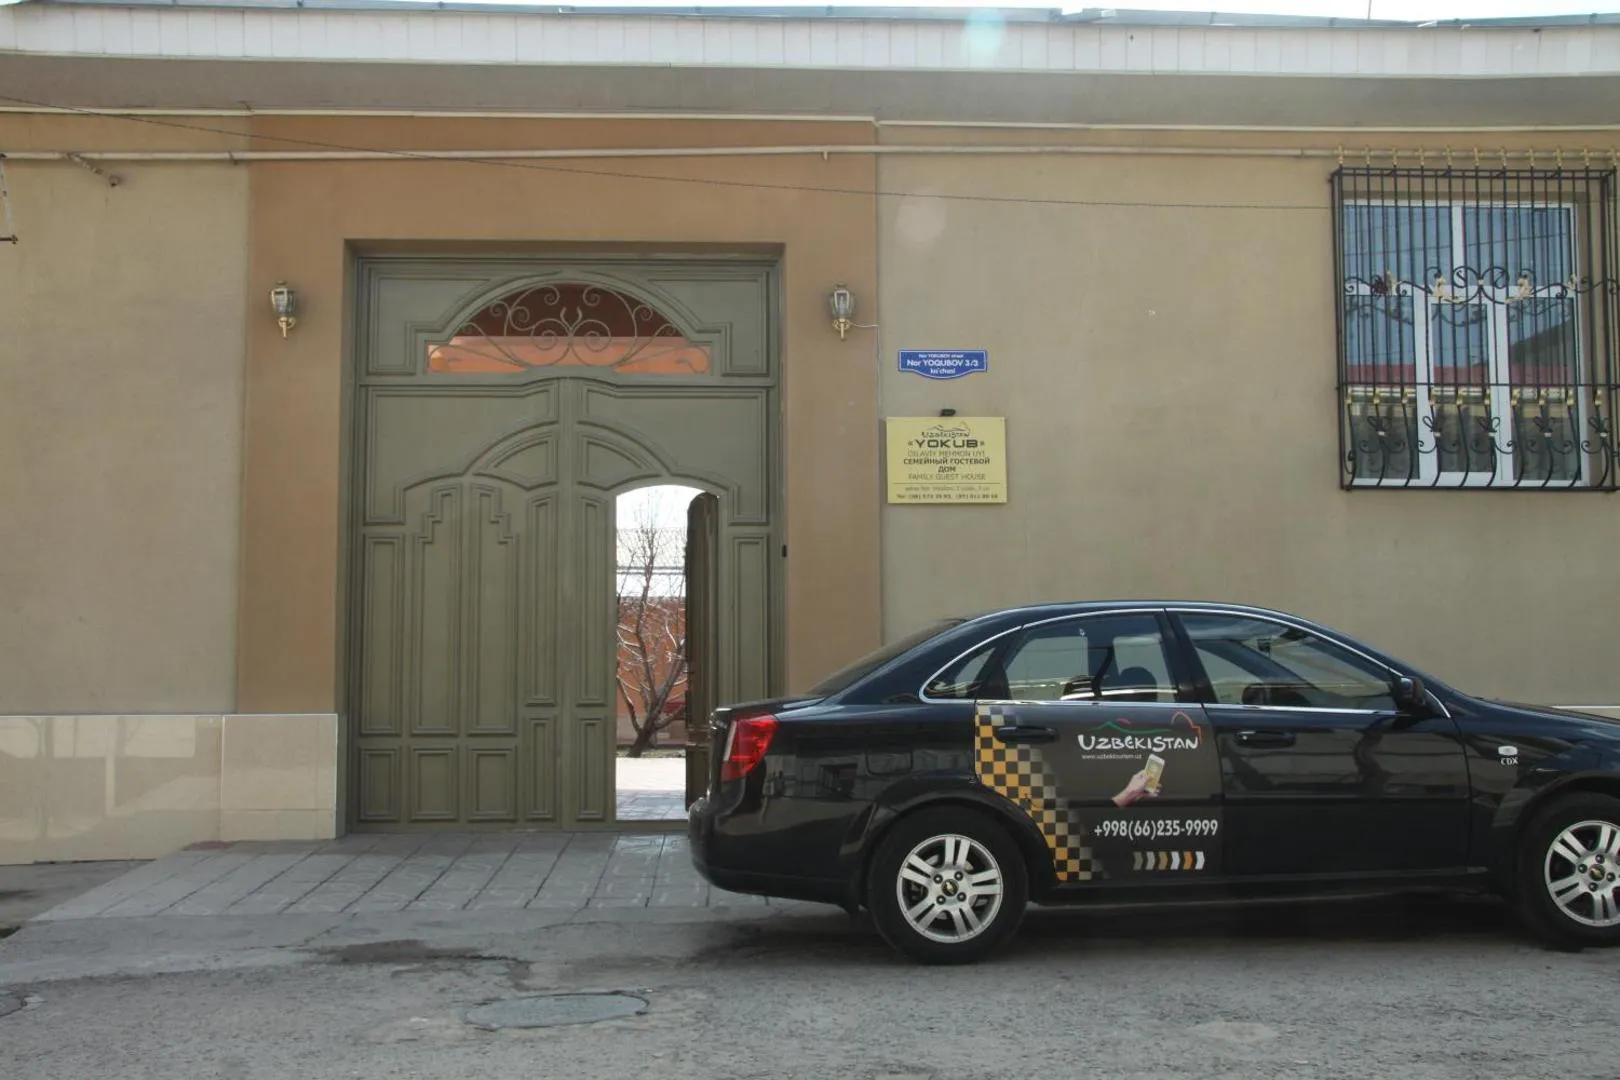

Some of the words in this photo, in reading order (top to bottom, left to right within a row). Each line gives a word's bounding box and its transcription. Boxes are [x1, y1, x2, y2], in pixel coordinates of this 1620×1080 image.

[923, 359, 964, 367] YOQUBOV
[903, 457, 948, 465] СЕМЕЙНЫЙ
[950, 457, 990, 465] ГОСТЕВОЙ
[1500, 757, 1518, 766] CDX
[1094, 819, 1219, 841] +998(66)235-9999
